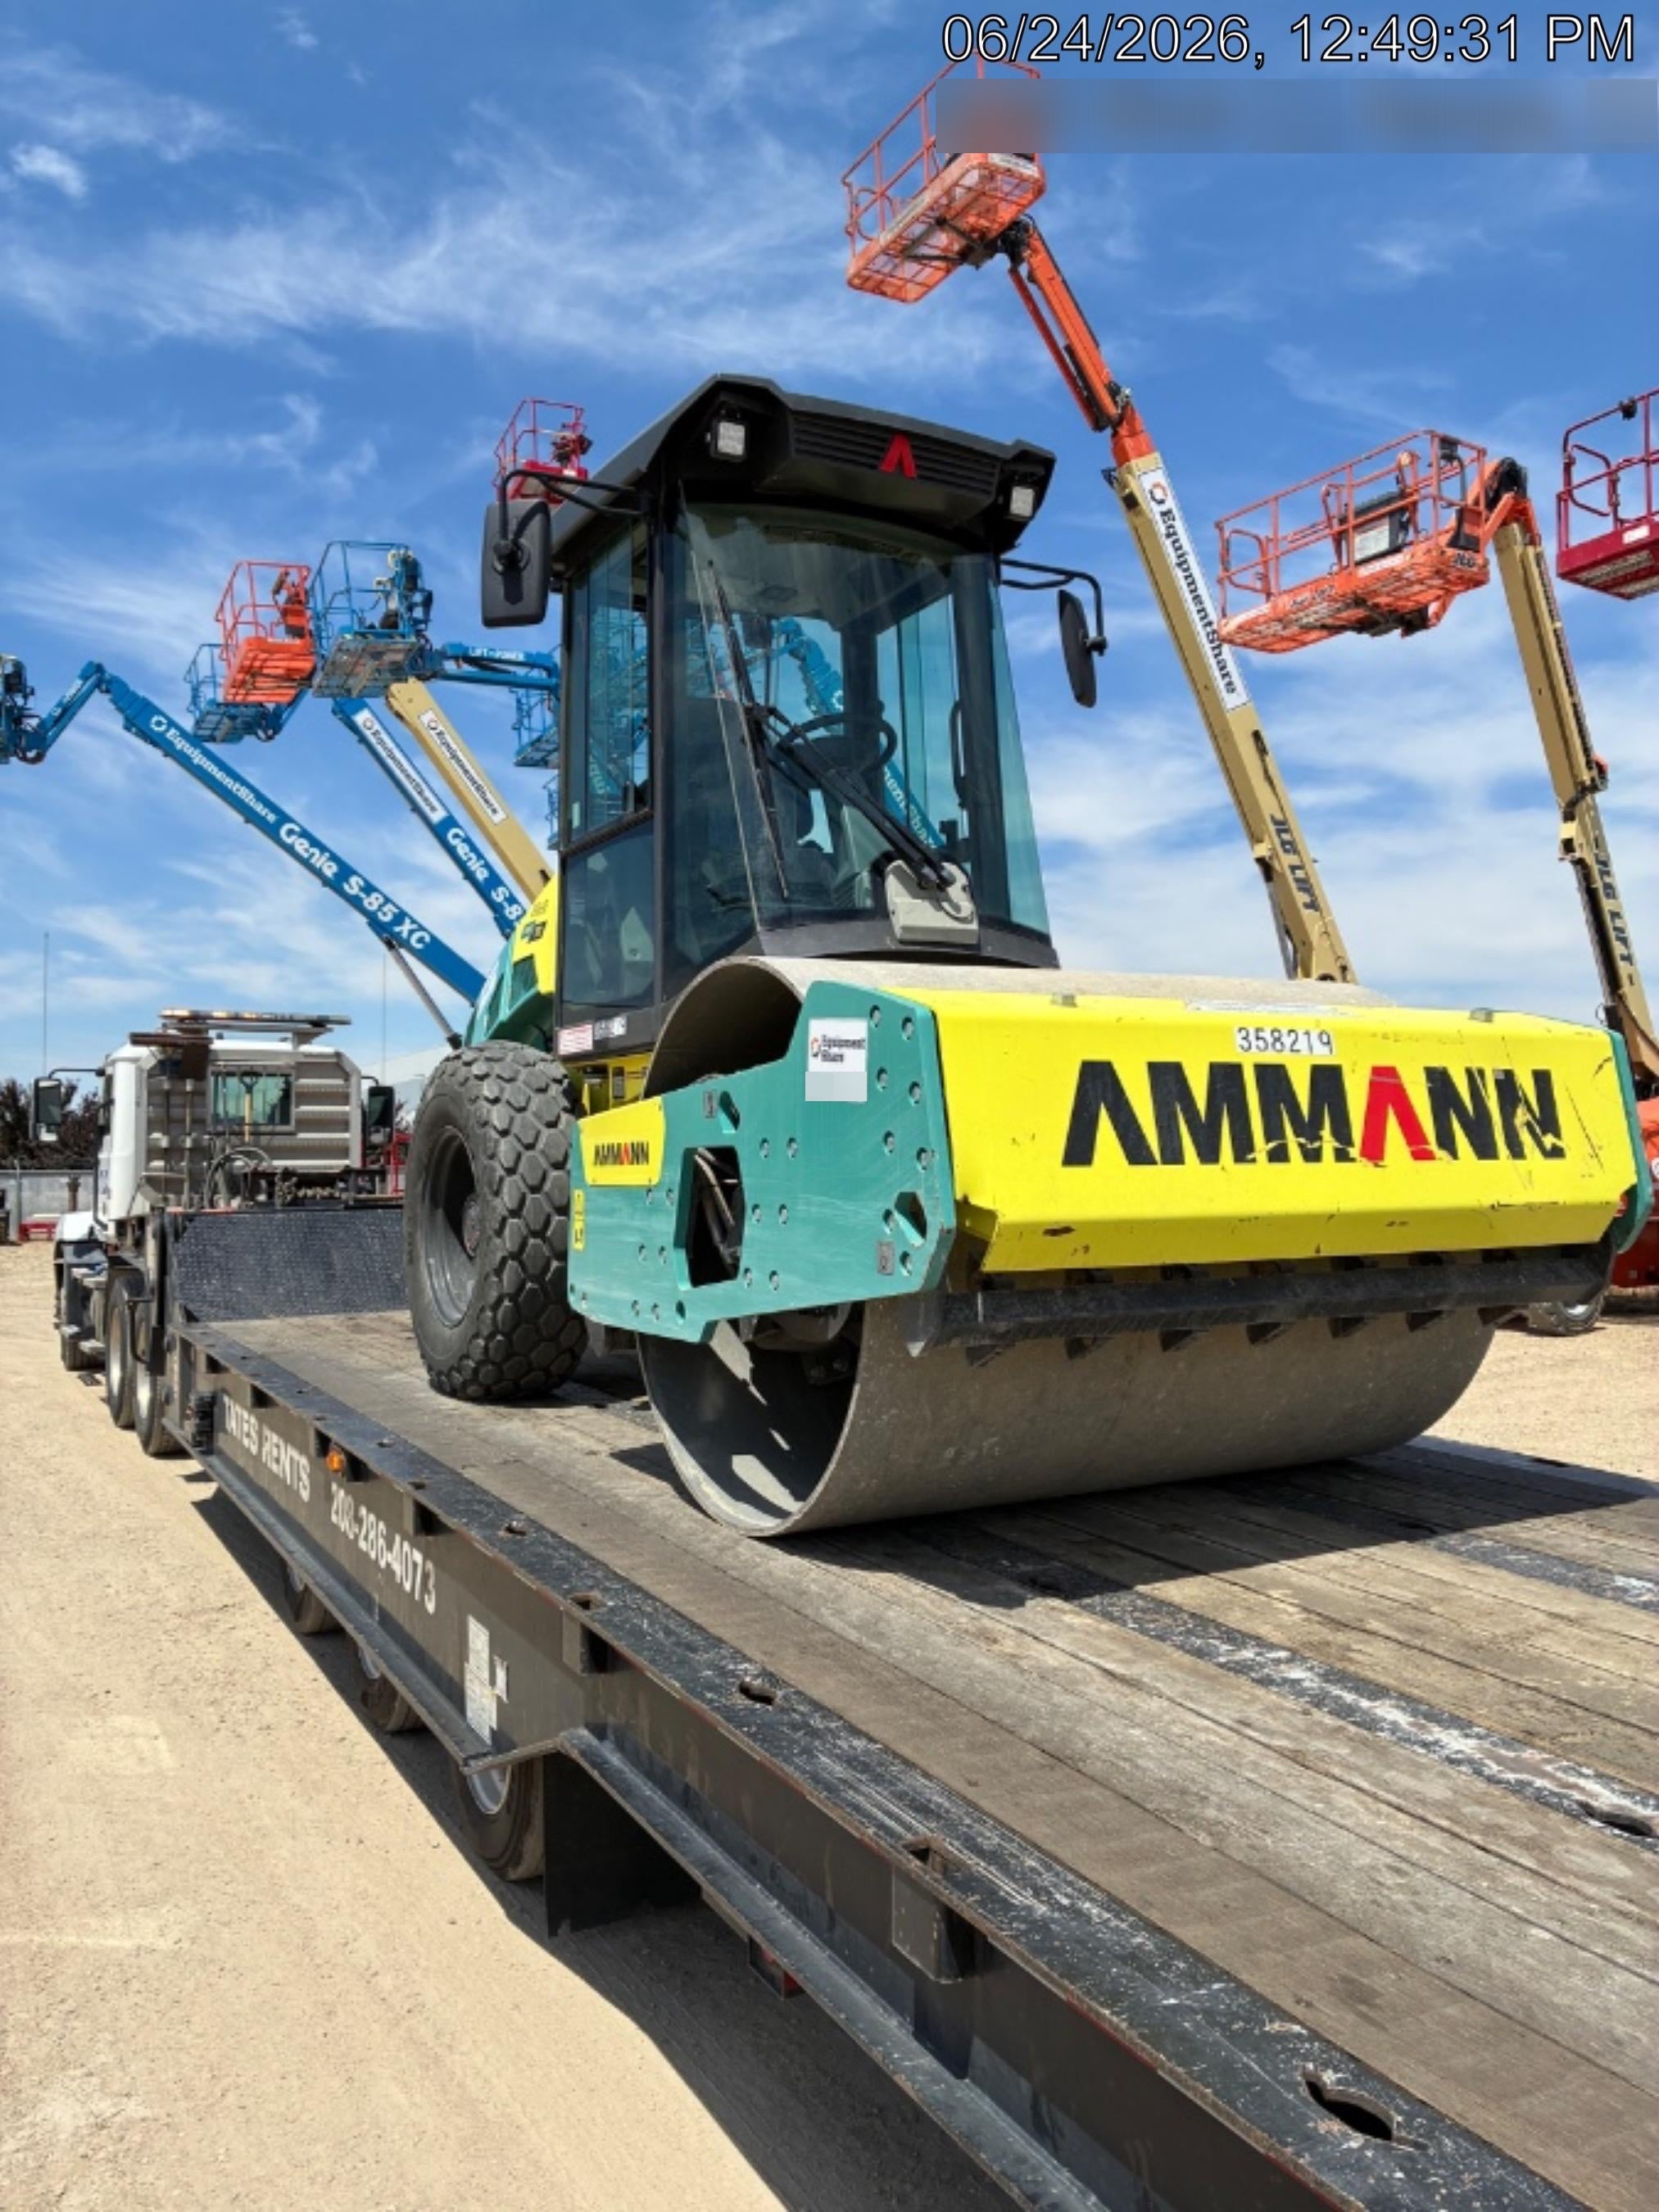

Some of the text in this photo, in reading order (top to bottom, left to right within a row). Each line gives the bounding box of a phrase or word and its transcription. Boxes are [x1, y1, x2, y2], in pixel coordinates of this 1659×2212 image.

[1160, 509, 1237, 695] EquipmentShare
[166, 727, 431, 950] EquipmentShare Genie S-85 XC
[446, 827, 489, 883] Genie
[1271, 814, 1299, 856] JLG
[820, 1034, 866, 1049] Equipment
[1237, 1027, 1334, 1055] 358219
[593, 1140, 650, 1167] AMMANN
[1061, 1058, 1566, 1167] AMMANN
[222, 1393, 310, 1503] TATES RENTS
[330, 1484, 437, 1615] 208-286-4073
